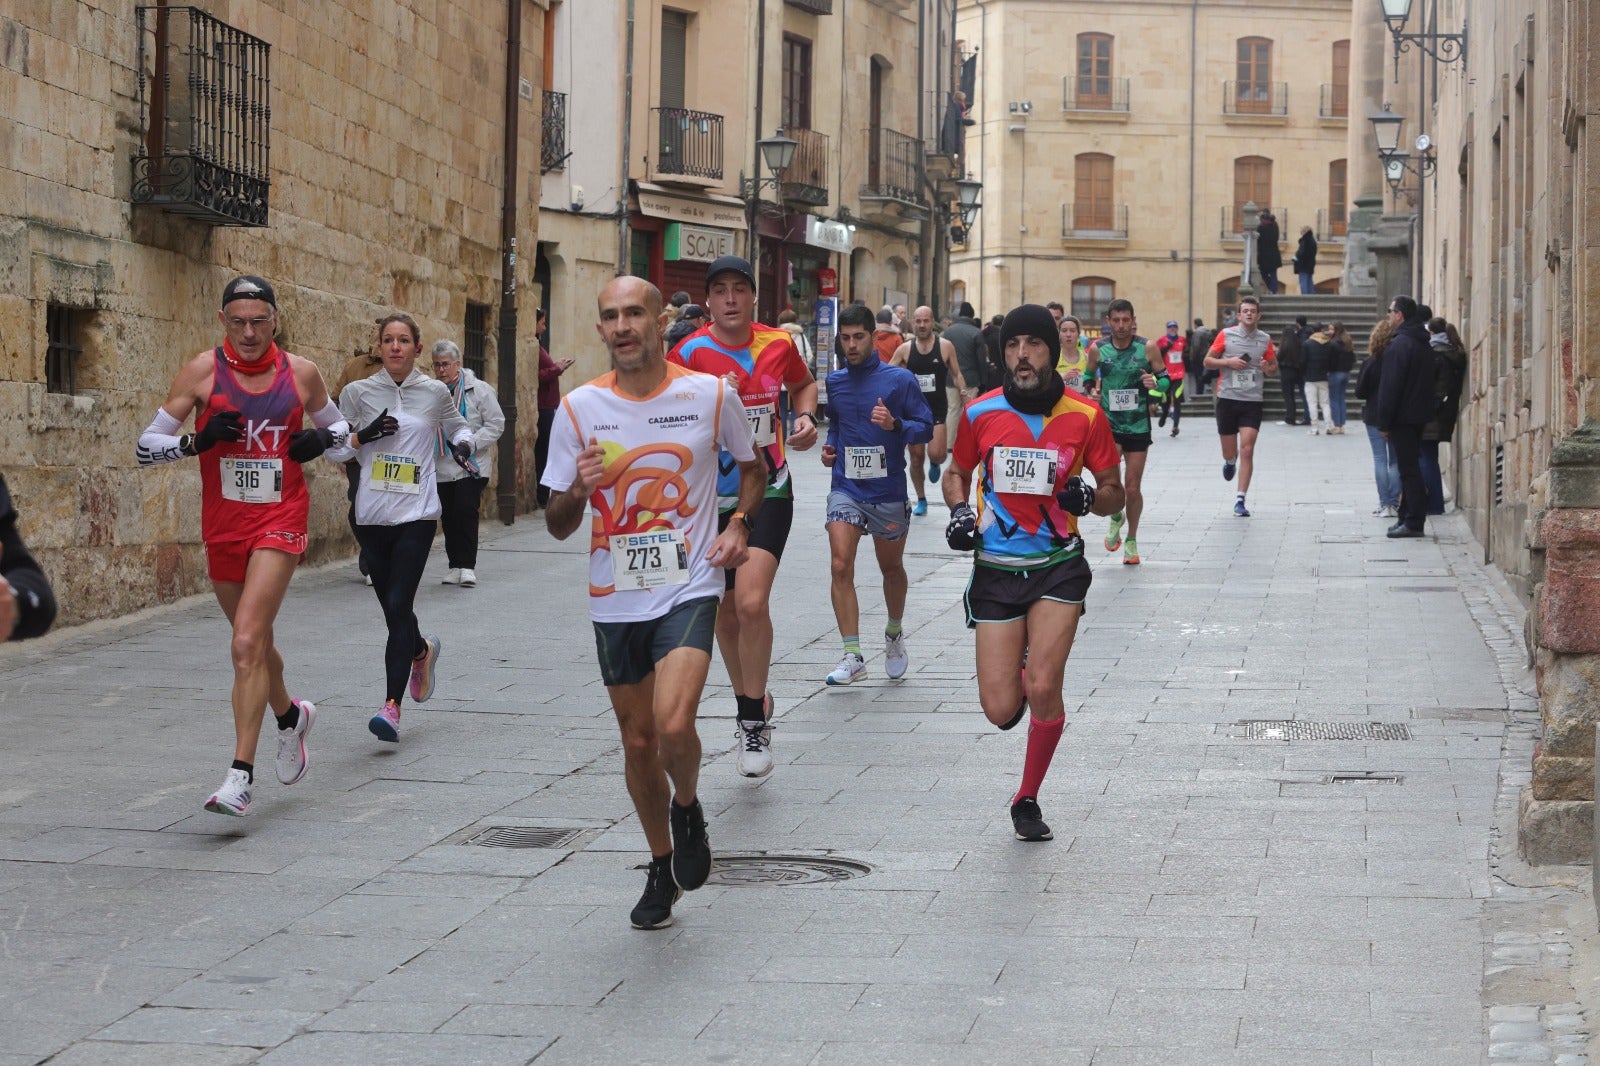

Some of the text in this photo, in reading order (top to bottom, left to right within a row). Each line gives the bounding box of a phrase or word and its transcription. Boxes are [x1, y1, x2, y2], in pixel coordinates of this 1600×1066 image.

[655, 203, 671, 215] away
[745, 407, 772, 416] ETEL
[648, 414, 699, 425] CAZABACHES
[593, 424, 611, 432] JUAN
[151, 446, 180, 462] EKT
[384, 454, 417, 465] SETEL
[1010, 449, 1052, 460] SETEL
[235, 461, 277, 470] SETEL
[852, 455, 872, 468] 702
[384, 462, 401, 479] 117
[1005, 459, 1036, 479] 304
[235, 470, 260, 488] 316
[628, 533, 677, 546] SETEL
[626, 546, 662, 571] 273
